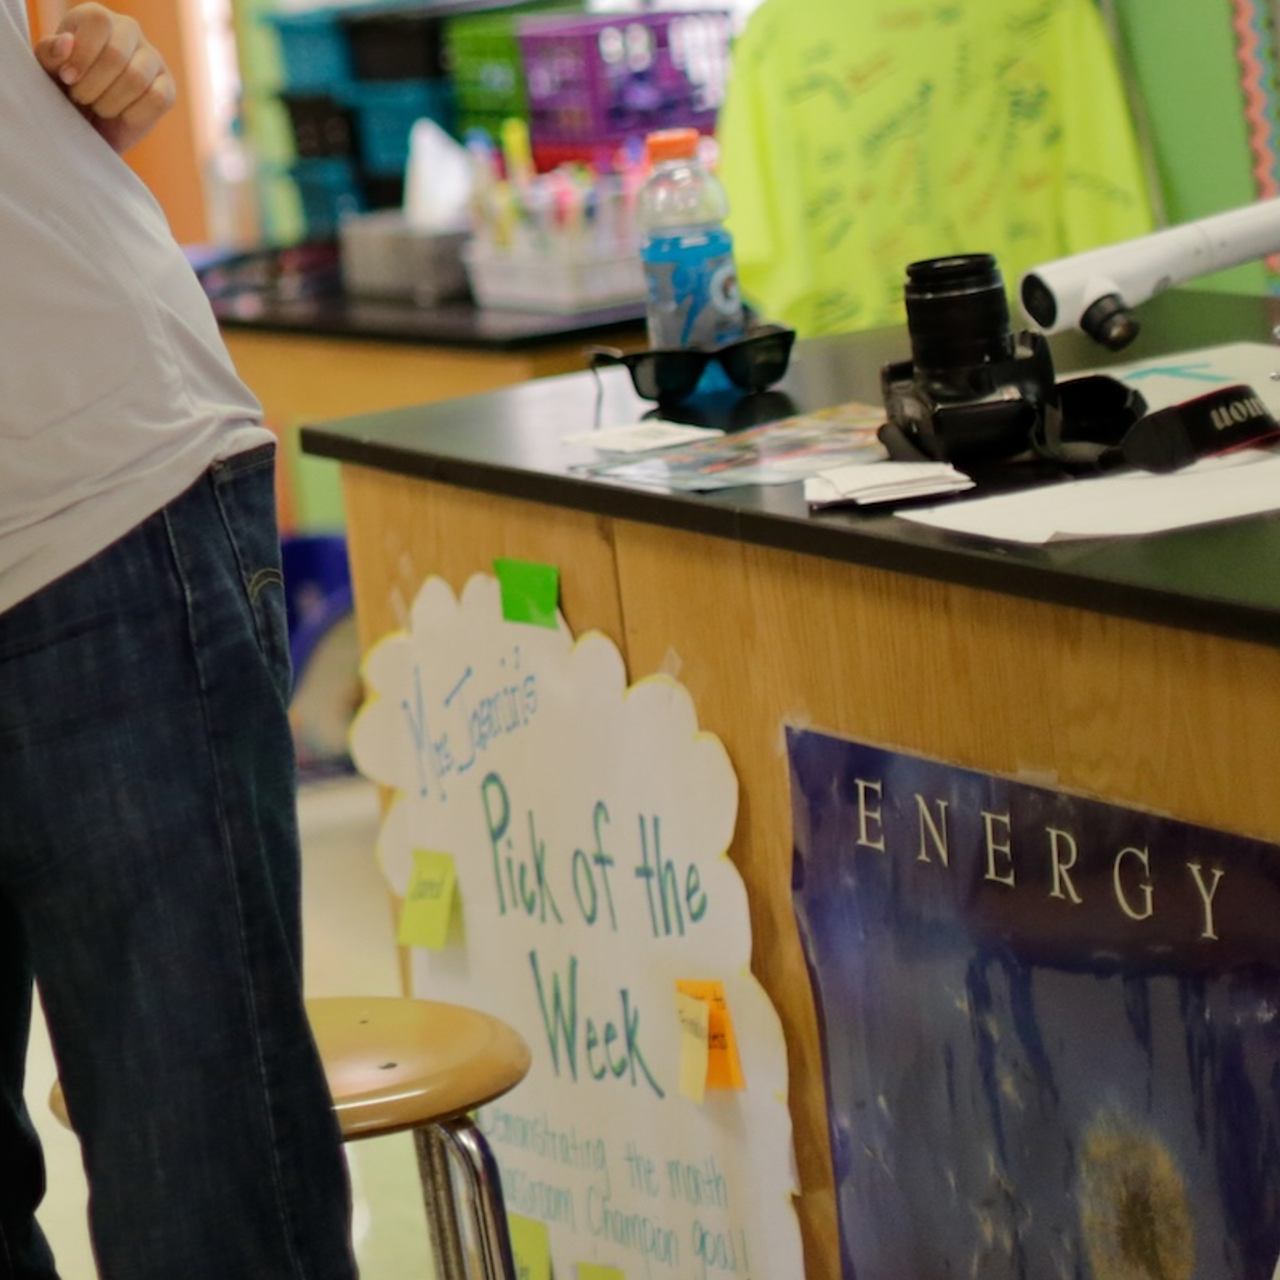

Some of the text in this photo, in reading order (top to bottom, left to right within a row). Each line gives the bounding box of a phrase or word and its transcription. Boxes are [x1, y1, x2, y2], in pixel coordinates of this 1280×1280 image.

[481, 771, 707, 937] Pick of the
[853, 777, 1225, 941] ENERGY
[529, 949, 665, 1099] Week
